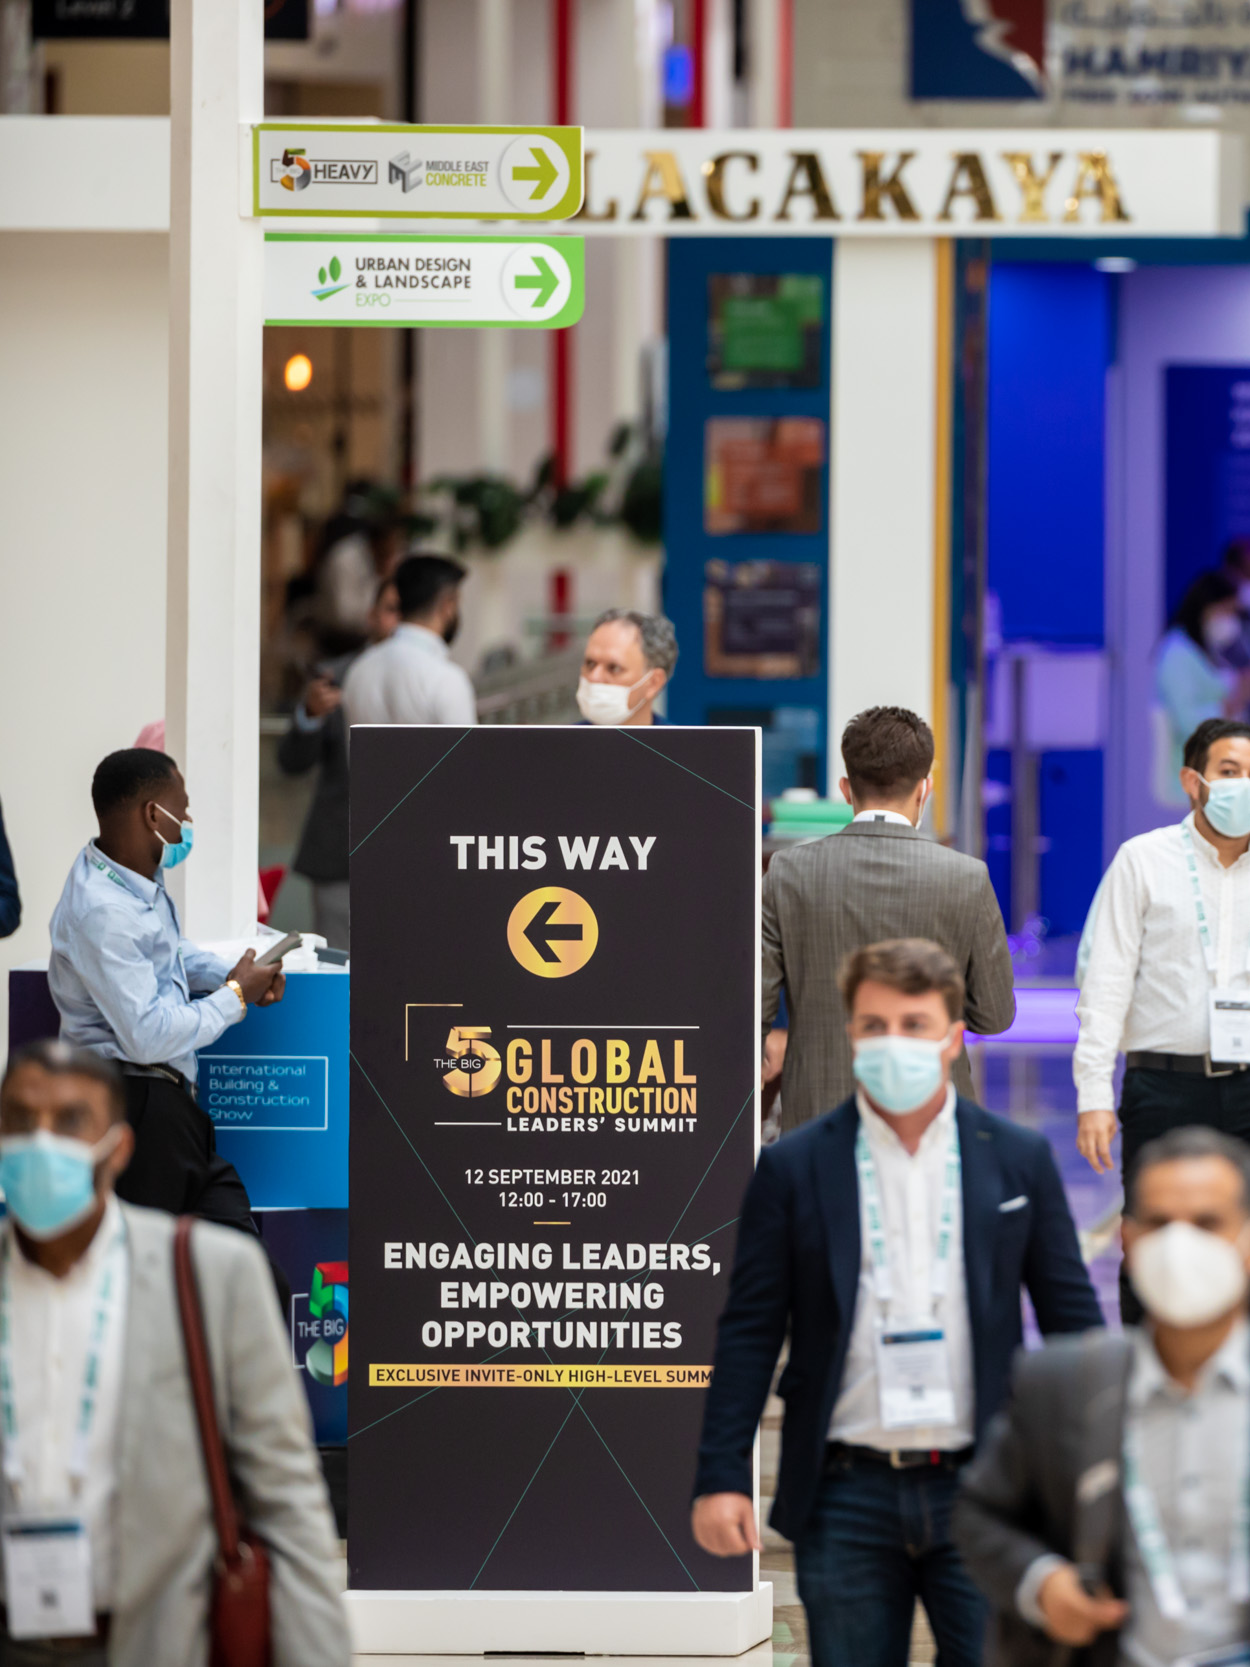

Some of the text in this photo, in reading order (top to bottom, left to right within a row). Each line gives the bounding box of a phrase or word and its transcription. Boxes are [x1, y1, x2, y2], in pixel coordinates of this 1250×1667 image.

[314, 164, 374, 180] HEAVY
[425, 161, 489, 172] MIDDLE EAST
[425, 173, 487, 187] CONCRETE
[566, 149, 1131, 223] LACAKAYA
[355, 257, 471, 271] URBAN DESIGN
[355, 275, 471, 289] & LANDSCAPE
[355, 293, 391, 307] EXPO
[450, 835, 657, 870] THIS WAY
[433, 1058, 482, 1069] THE BIG
[506, 1038, 697, 1084] GLOBAL
[208, 1063, 306, 1077] International
[208, 1078, 280, 1093] Building &
[208, 1093, 310, 1107] Construction
[506, 1086, 697, 1114] CONSTRUCTION
[208, 1108, 253, 1121] Show
[614, 1117, 698, 1132] SUMMIT
[464, 1169, 640, 1185] 12 SEPTEMBER 2021
[499, 1192, 544, 1208] 12:00
[562, 1192, 607, 1208] 17:00
[384, 1242, 721, 1276] ENGAGING LEADERS,
[440, 1282, 665, 1309] EMPOWERING
[298, 1318, 345, 1337] THE BIG
[421, 1321, 683, 1349] OPPORTUNITIES
[376, 1369, 713, 1383] EXCLUSIVE INVITE-ONLY HIGH-LEVEL SUMM
